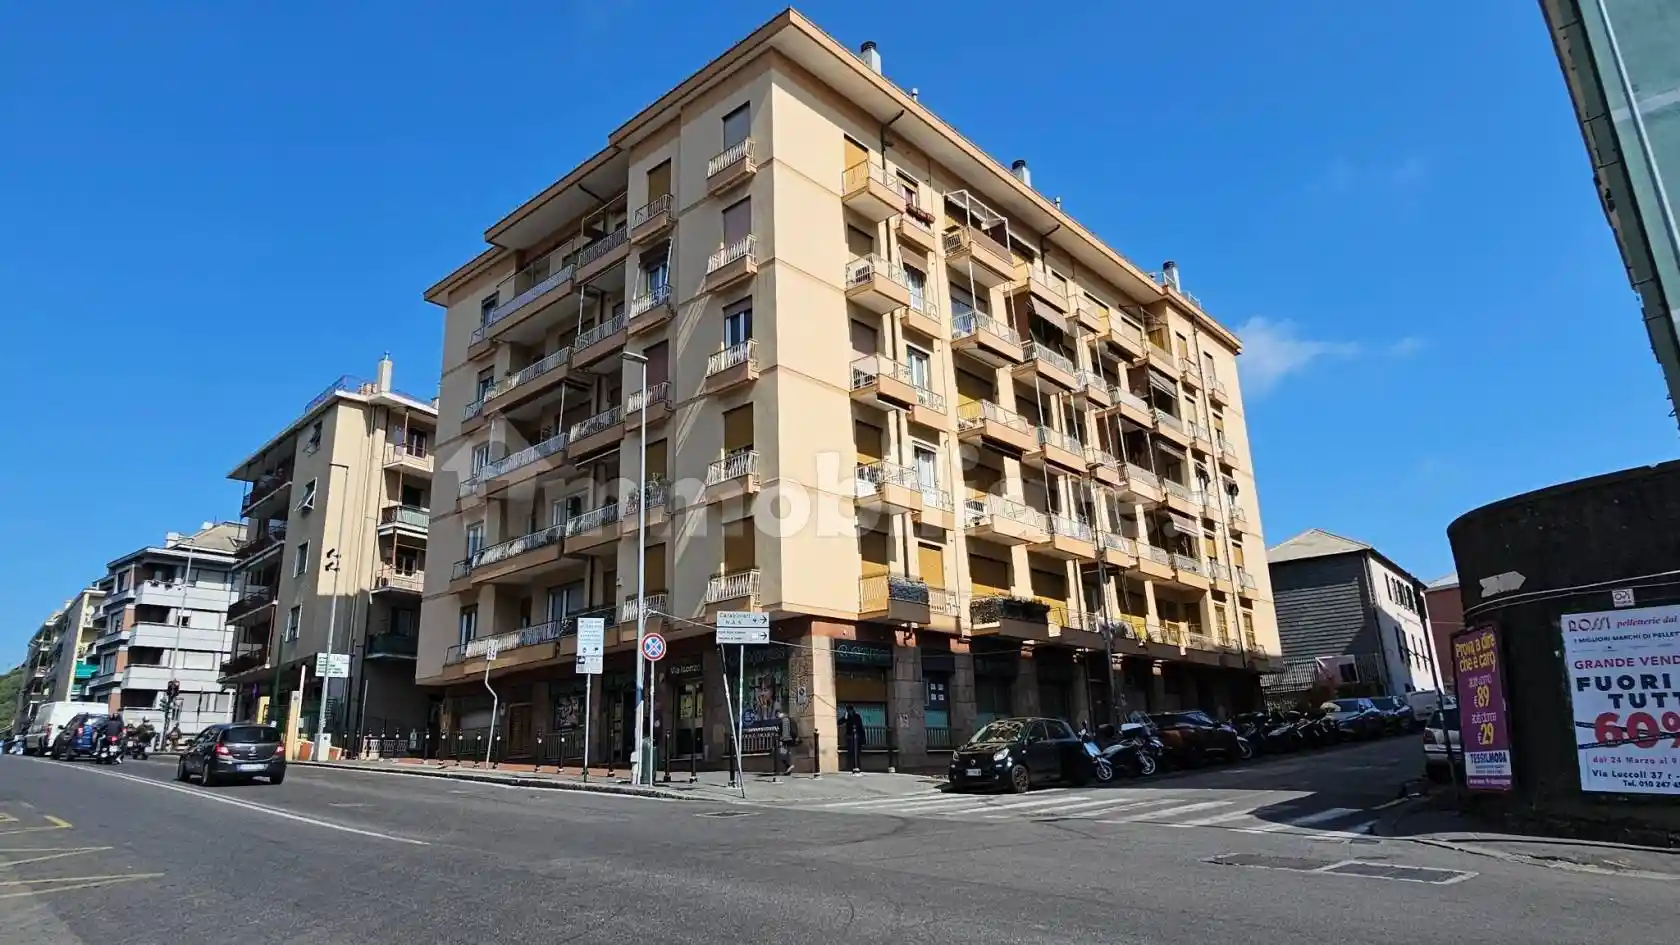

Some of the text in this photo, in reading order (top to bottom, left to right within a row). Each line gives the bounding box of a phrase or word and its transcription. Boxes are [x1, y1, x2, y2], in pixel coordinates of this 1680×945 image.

[1475, 638, 1481, 651] a
[1578, 635, 1611, 643] MIGLIORI
[1459, 656, 1473, 672] che
[1574, 655, 1680, 670] GRANDE VEND
[1576, 673, 1672, 692] FUORI
[1625, 756, 1655, 764] Marzo
[1660, 756, 1667, 764] al
[1591, 769, 1608, 777] Via
[1650, 771, 1663, 779] 37
